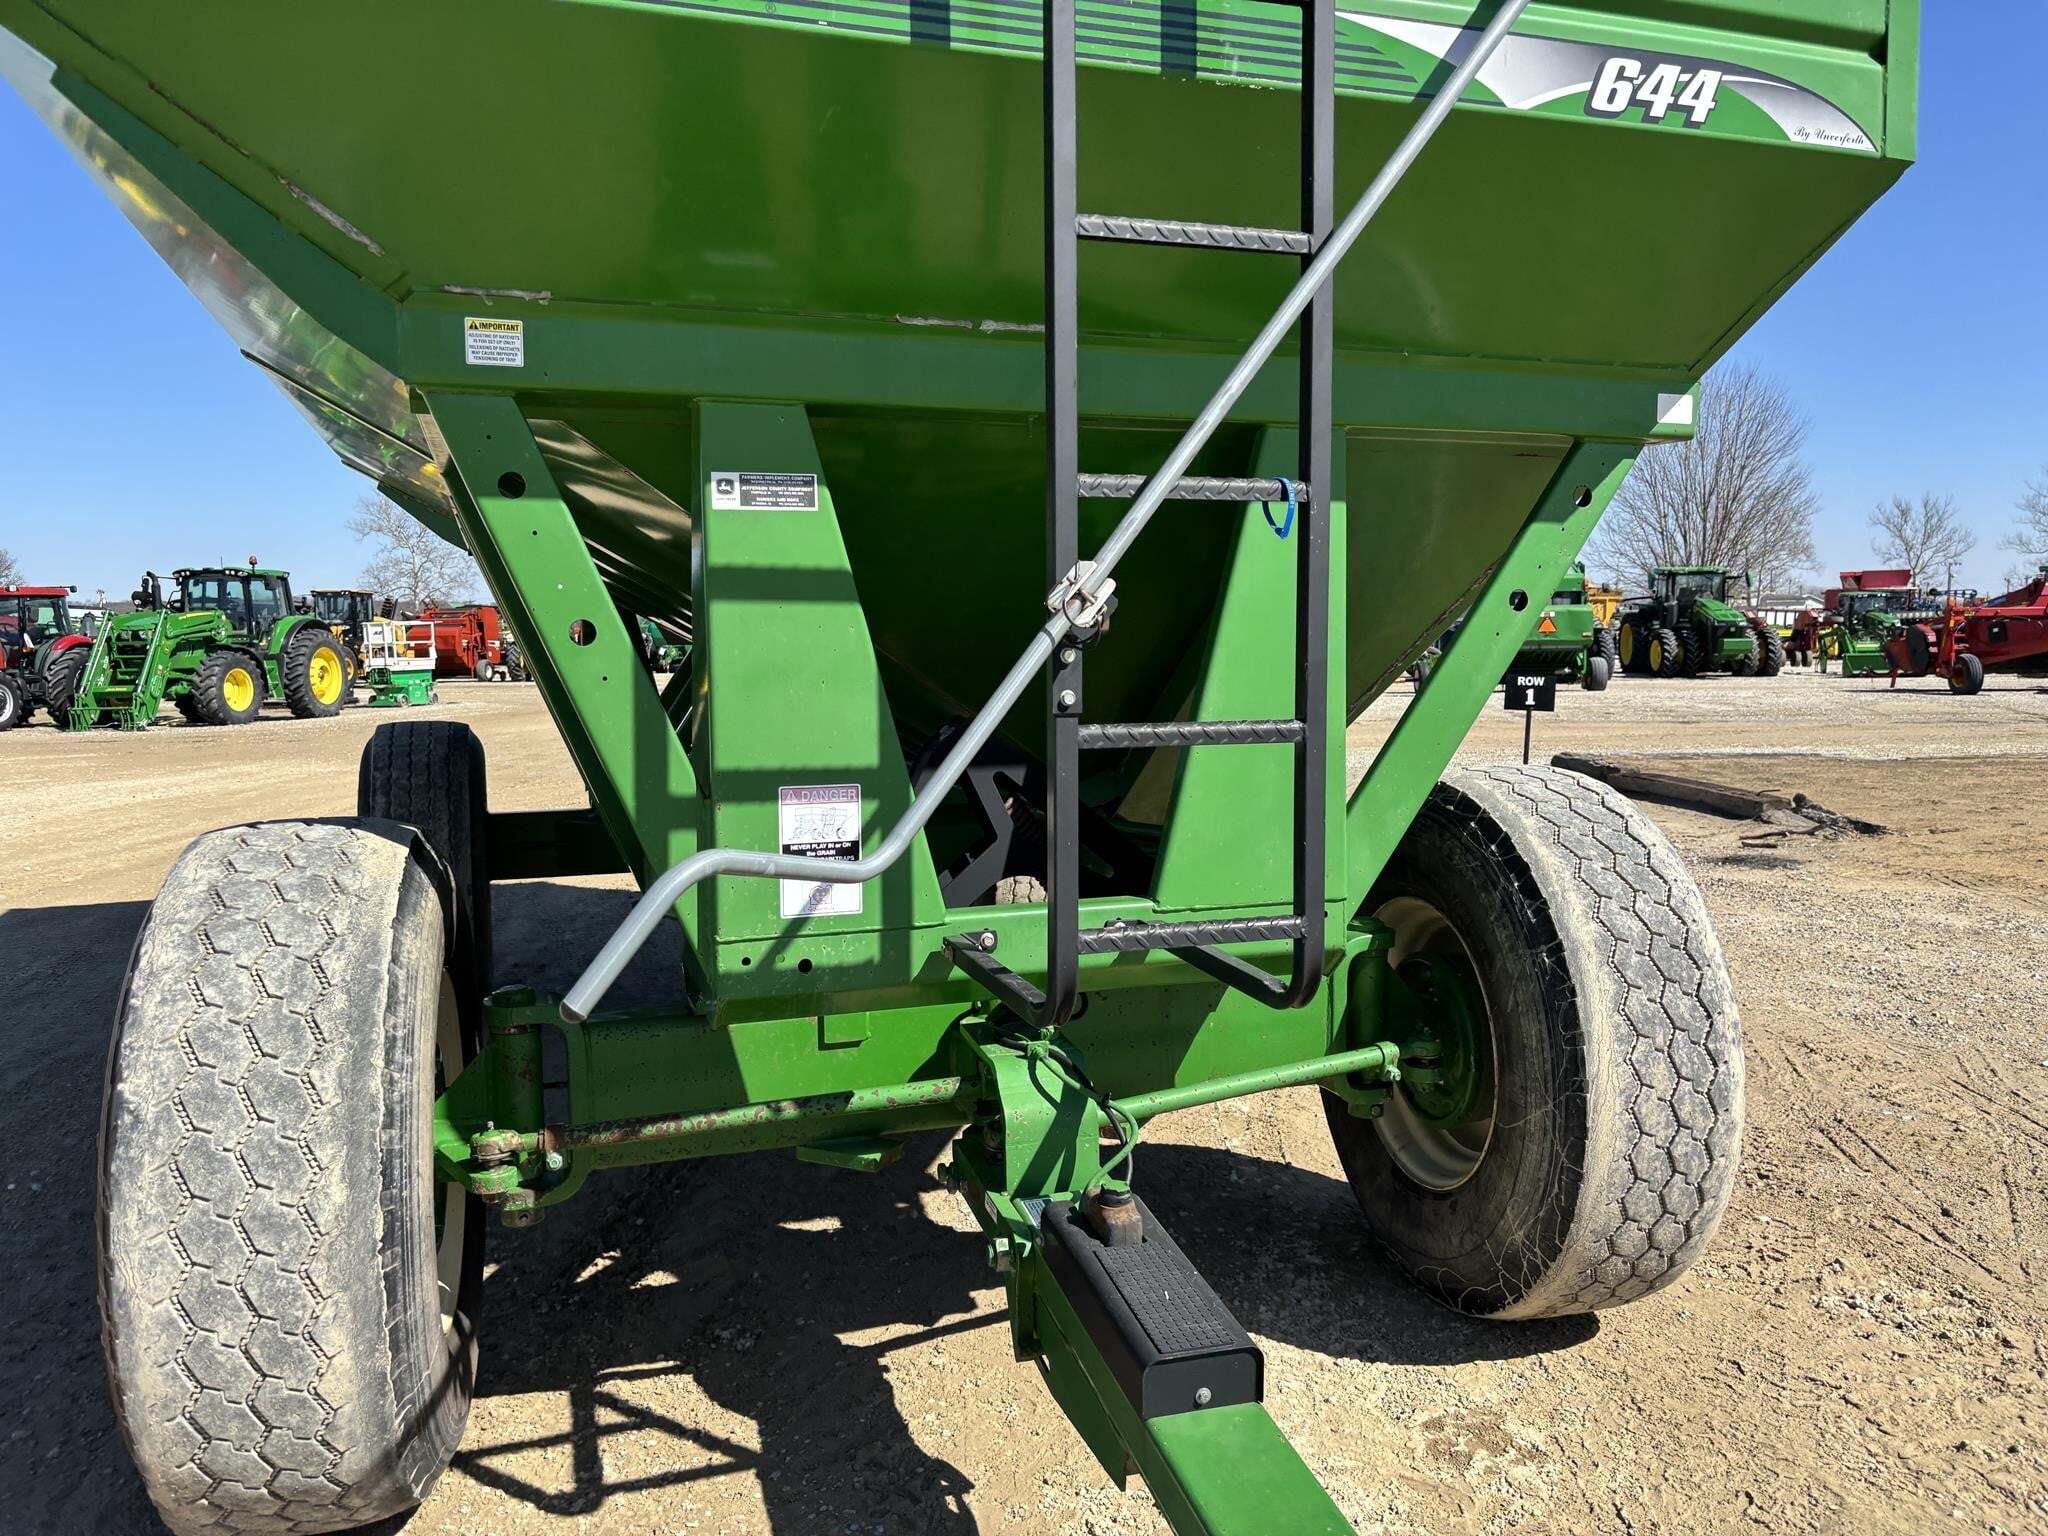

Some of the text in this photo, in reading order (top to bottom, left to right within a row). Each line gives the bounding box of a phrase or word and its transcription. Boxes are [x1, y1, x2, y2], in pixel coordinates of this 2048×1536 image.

[1591, 58, 1722, 122] 644
[1794, 126, 1810, 140] By
[480, 322, 520, 331] IMPORTANT
[1517, 676, 1545, 686] ROW
[1525, 688, 1535, 705] 1
[801, 789, 858, 802] DANGER
